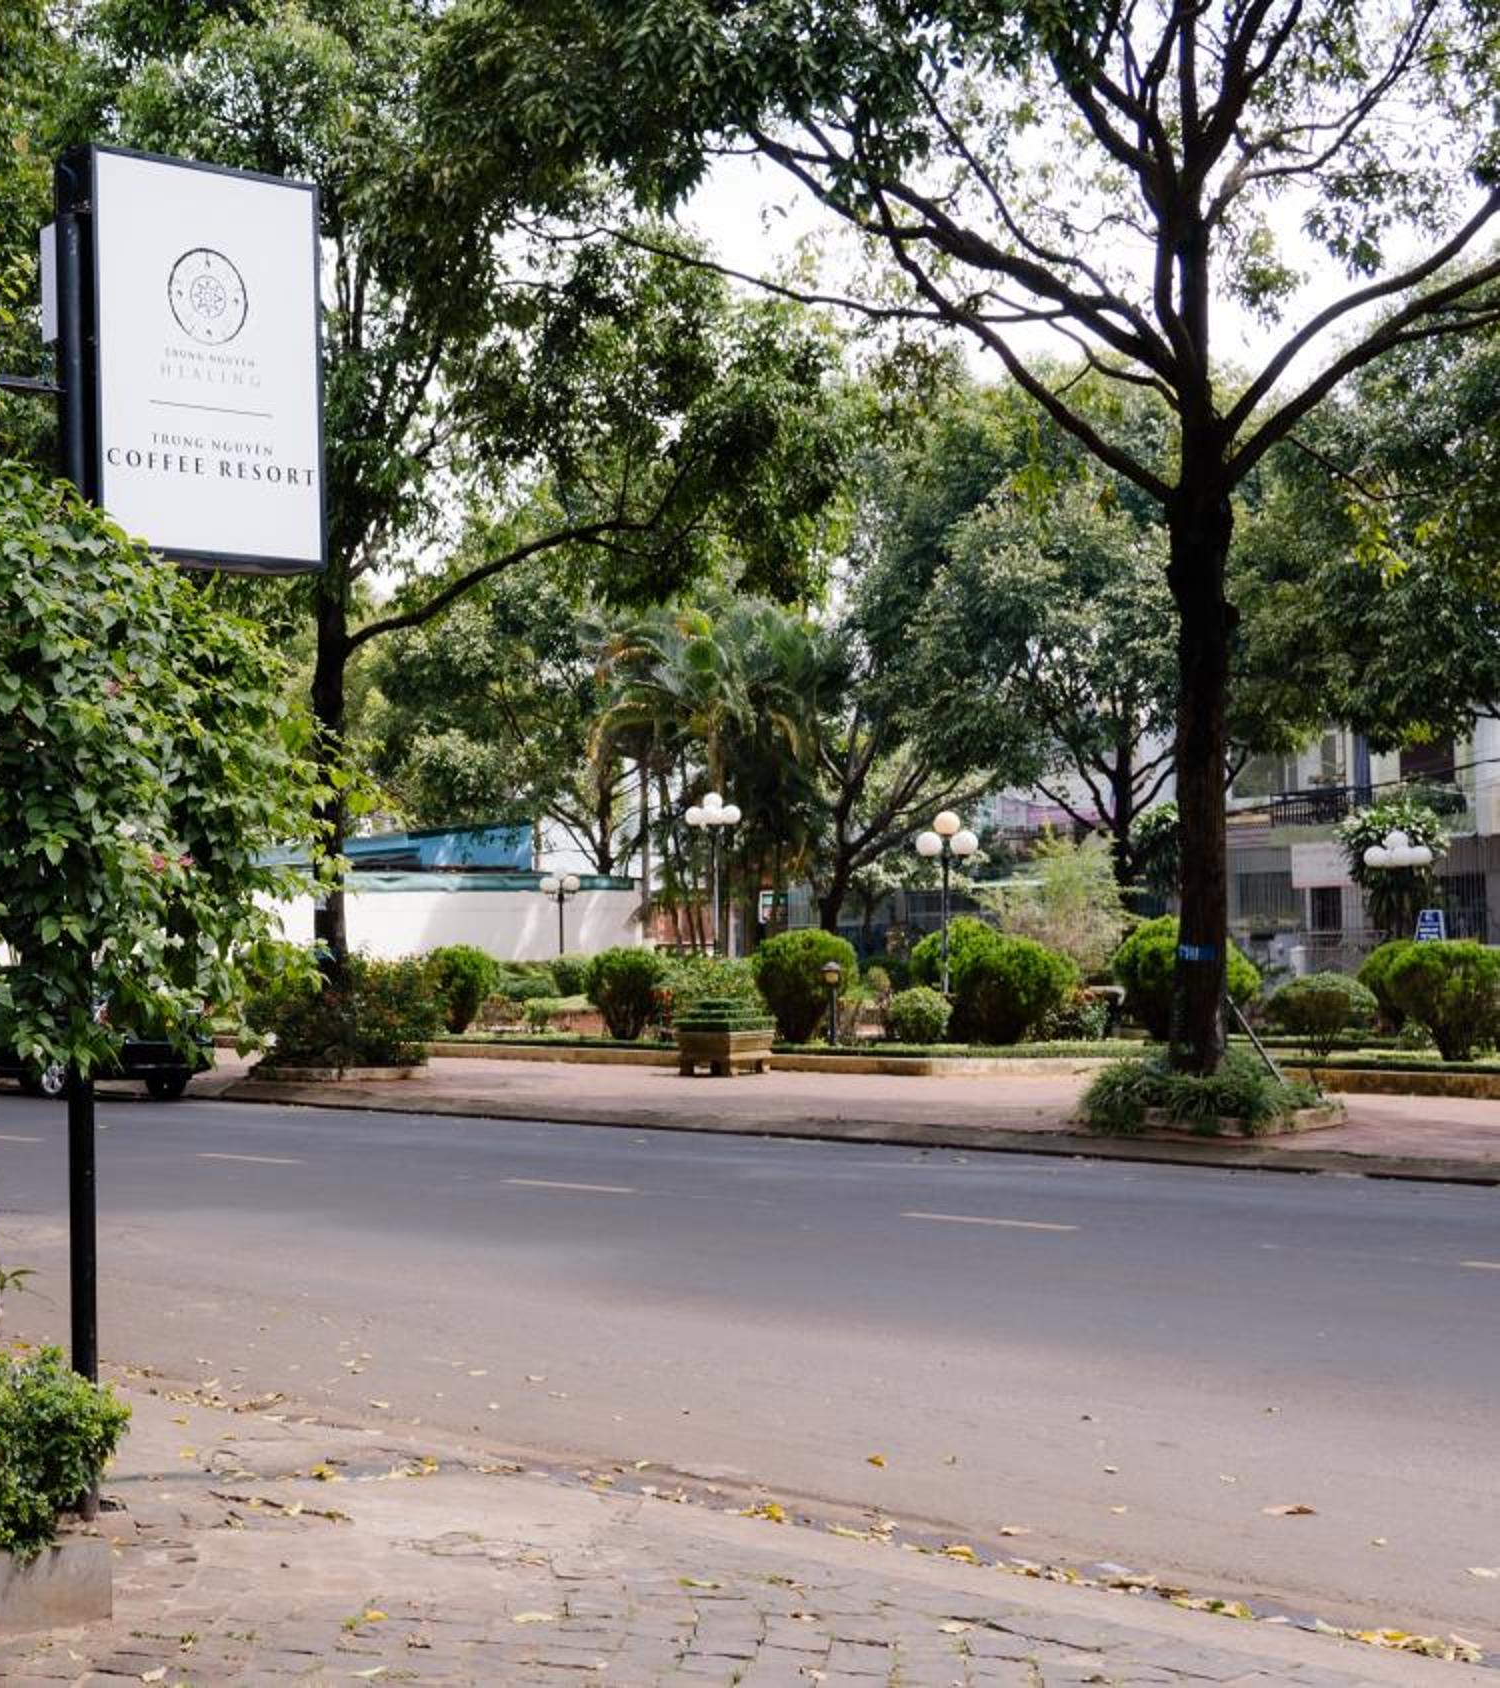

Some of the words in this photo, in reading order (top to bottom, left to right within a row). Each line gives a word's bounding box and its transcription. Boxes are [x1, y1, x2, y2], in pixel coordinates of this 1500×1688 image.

[151, 432, 204, 449] TRUNG
[107, 447, 204, 475] COFFEE
[219, 460, 315, 486] RESORT
